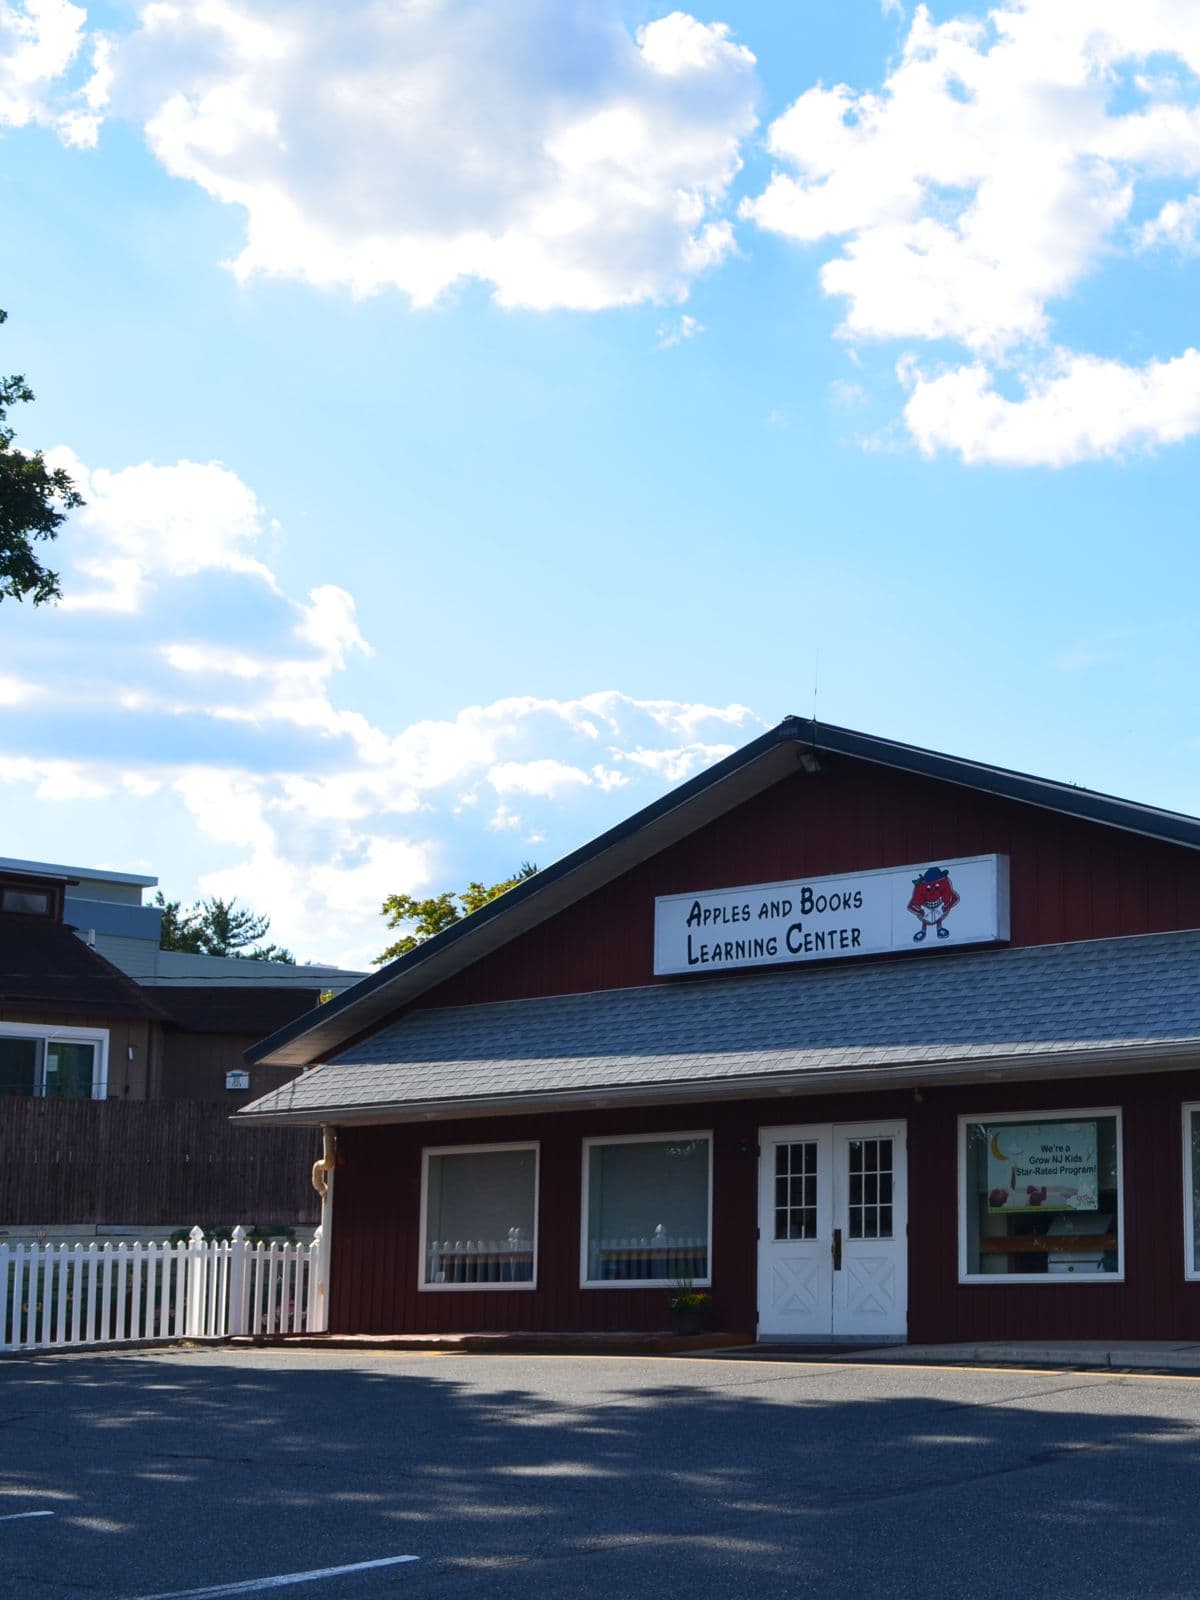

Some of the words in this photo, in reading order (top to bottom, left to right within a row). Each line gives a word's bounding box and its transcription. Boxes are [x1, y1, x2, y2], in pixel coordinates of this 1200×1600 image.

[1040, 1144, 1063, 1153] We're
[1029, 1156, 1050, 1164] Grow
[1052, 1154, 1063, 1164] NJ
[1065, 1154, 1083, 1163] Kids
[1016, 1167, 1058, 1176] Star-Rated
